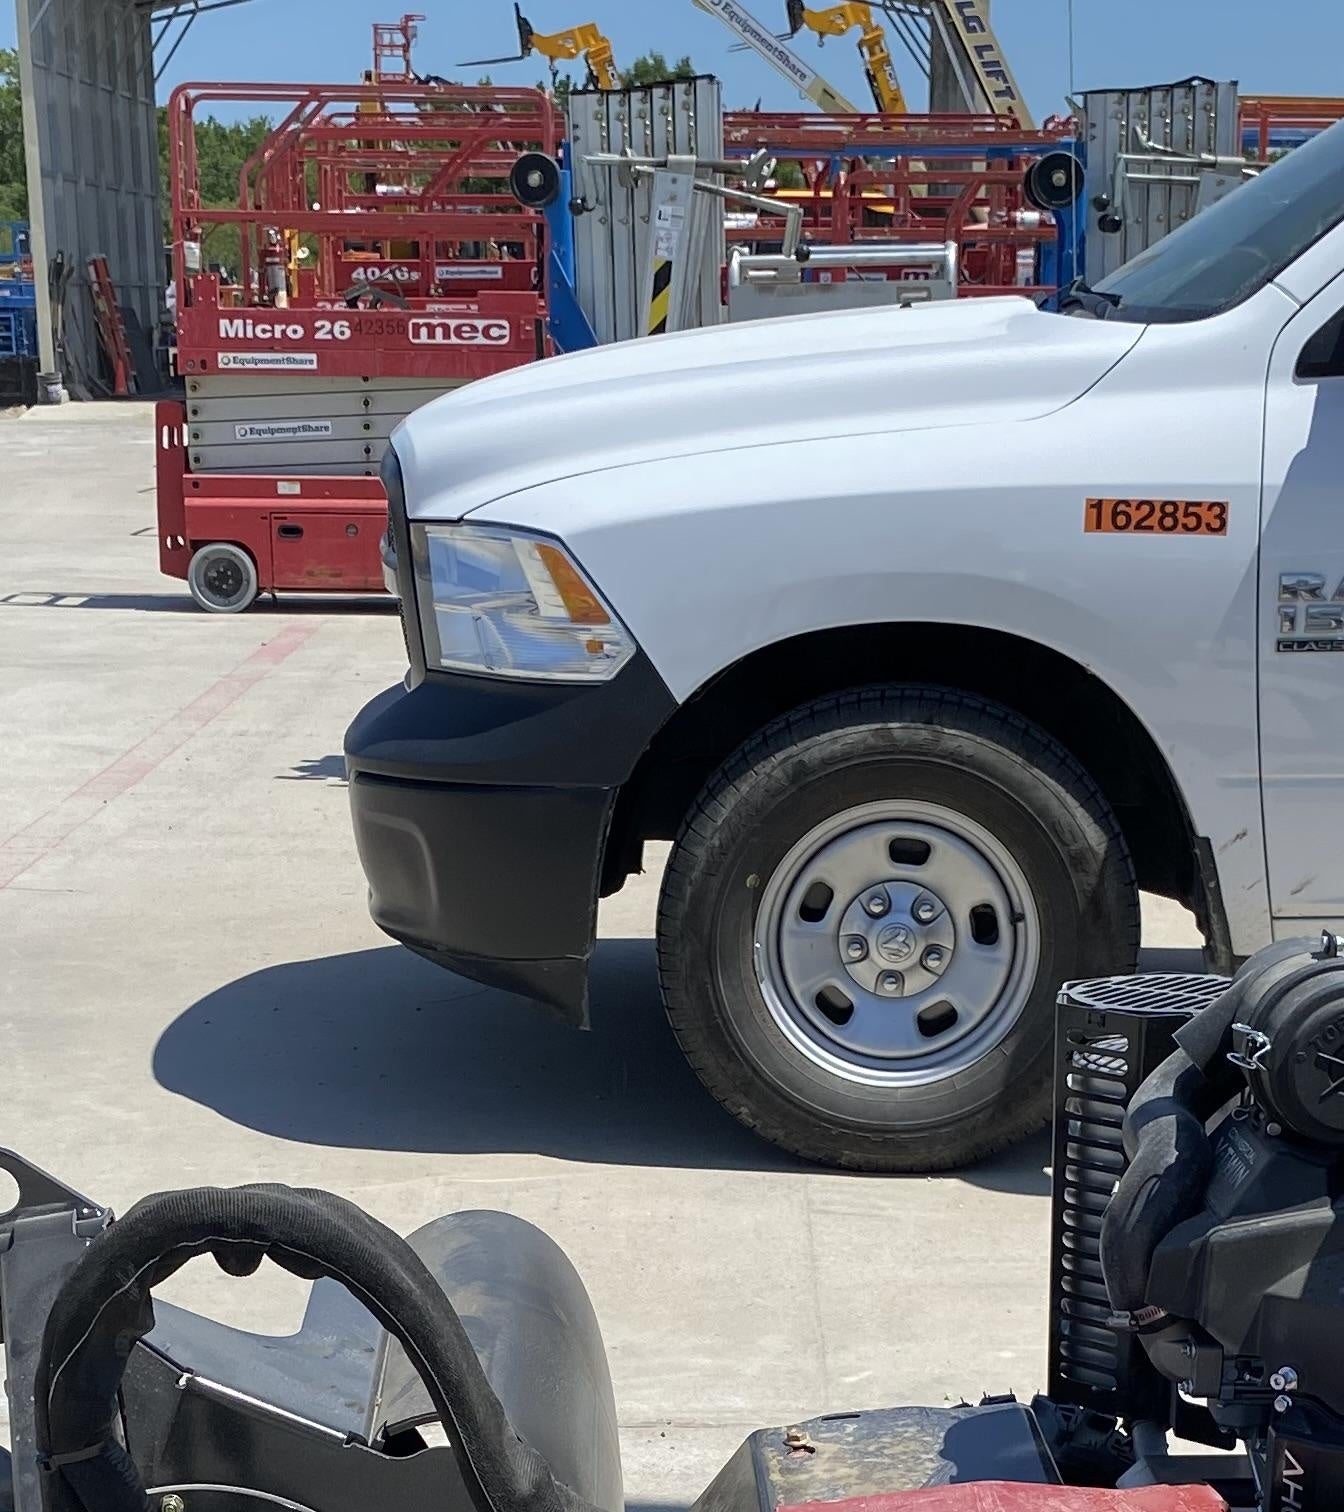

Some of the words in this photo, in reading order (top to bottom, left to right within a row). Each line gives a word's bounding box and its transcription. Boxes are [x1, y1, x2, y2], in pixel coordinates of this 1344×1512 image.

[721, 1, 806, 81] EquipmentShare
[973, 44, 1016, 111] LIFT
[218, 319, 304, 340] Micro
[314, 319, 351, 340] 26
[411, 321, 507, 343] mec
[232, 355, 314, 368] EquipmentShare
[249, 423, 330, 436] EquipmentShare
[1088, 500, 1227, 532] 162853
